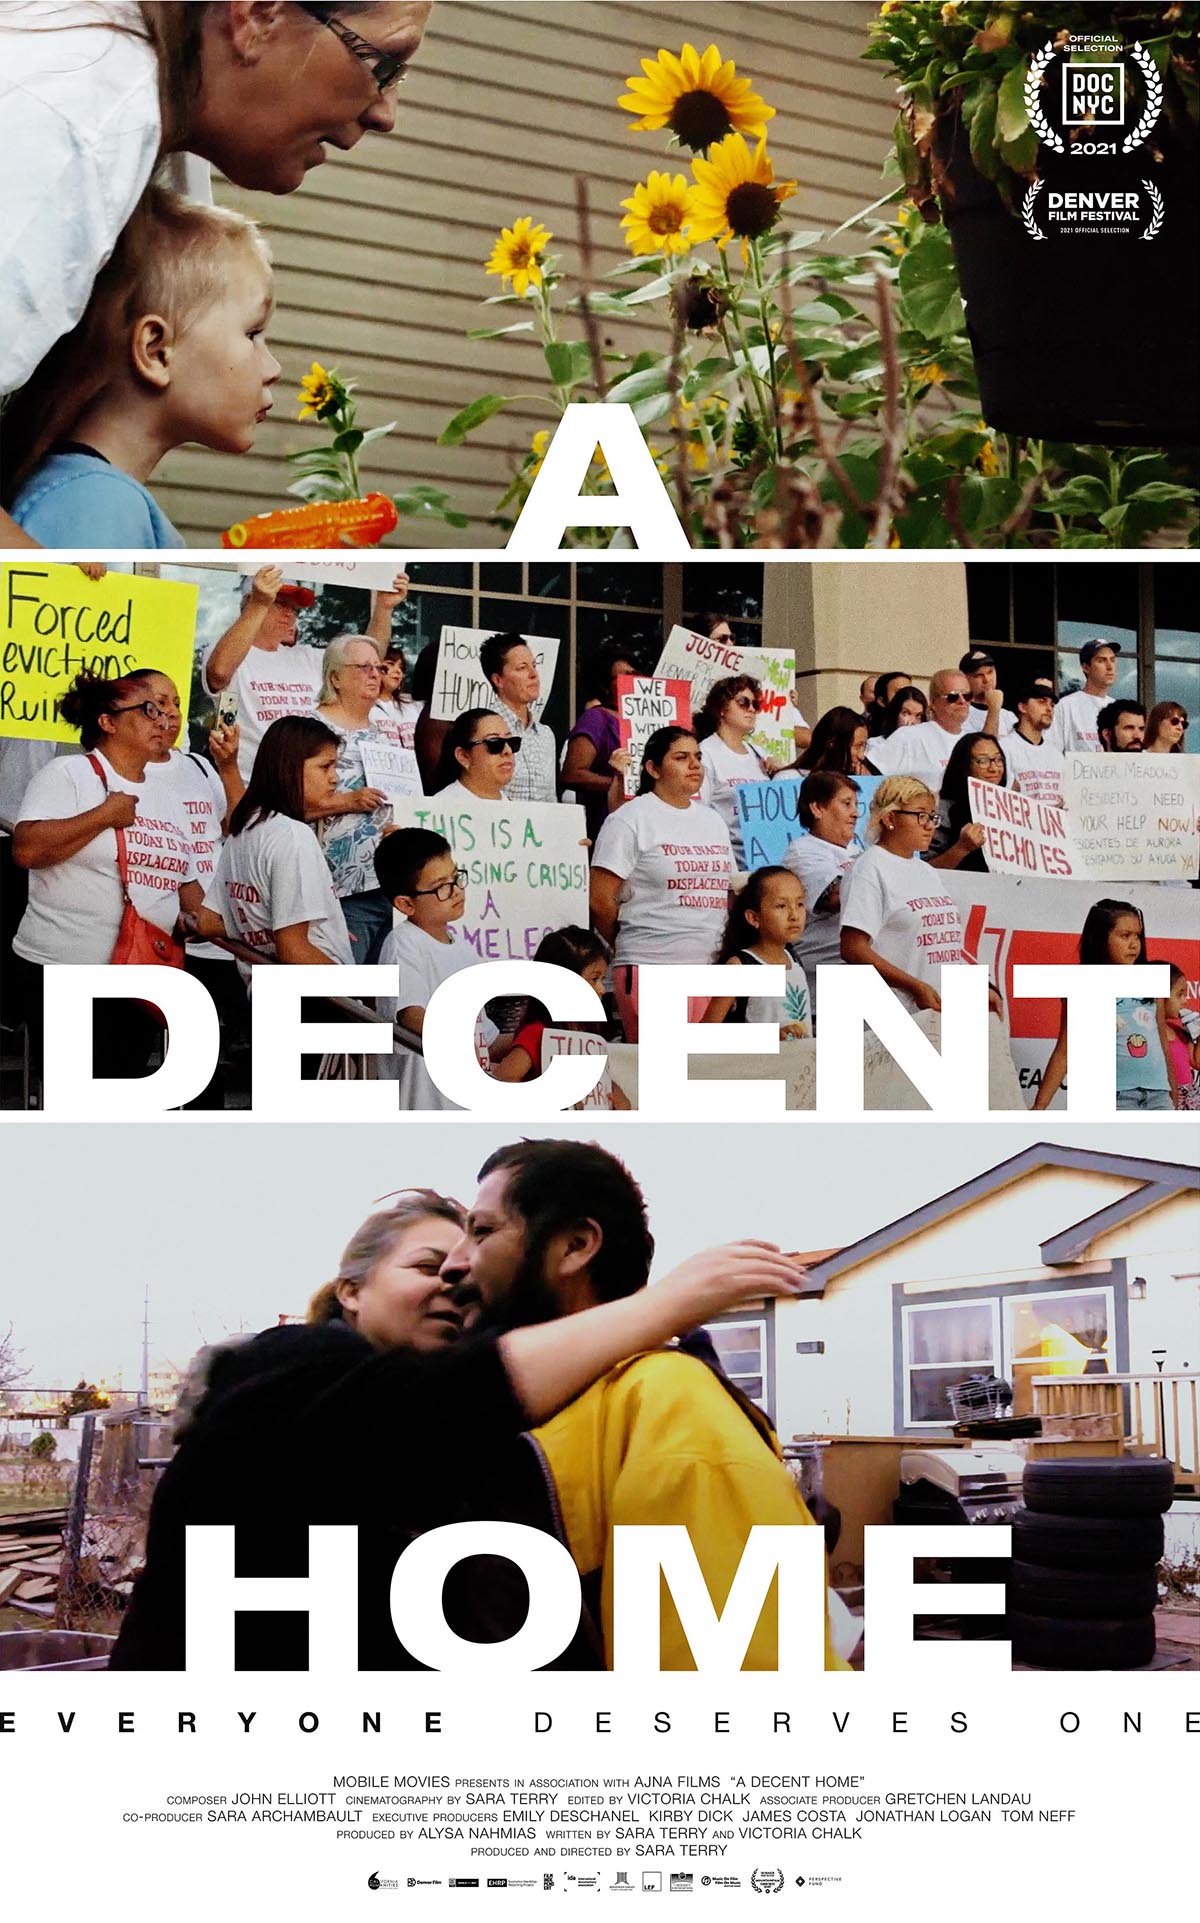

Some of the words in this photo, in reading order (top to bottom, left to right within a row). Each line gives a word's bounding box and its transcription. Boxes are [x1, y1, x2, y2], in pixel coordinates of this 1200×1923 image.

[8, 570, 133, 646] Forced
[685, 633, 744, 672] JUSTICE
[637, 679, 664, 697] WE
[624, 697, 674, 717] STAND
[1073, 759, 1120, 780] DENVER
[1153, 792, 1185, 807] NEED
[970, 782, 1033, 830] TENER
[1037, 804, 1067, 839] UN
[414, 810, 476, 851] THIS
[491, 818, 512, 850] IS
[522, 817, 543, 848] A
[1080, 814, 1109, 832] YOUR
[1117, 814, 1147, 831] HELP
[127, 830, 164, 849] TODAY
[661, 843, 693, 856] YOUR
[751, 837, 769, 865] A
[981, 824, 1037, 872] ECHO
[1040, 845, 1073, 877] ES
[526, 860, 587, 893] CRISIS!
[674, 860, 709, 873] TODAY
[712, 860, 721, 873] IS
[127, 870, 181, 893] TOMORR
[667, 877, 732, 891] DISPLACEME
[479, 889, 501, 921] A
[921, 912, 945, 927] TODAY
[946, 911, 955, 925] IS
